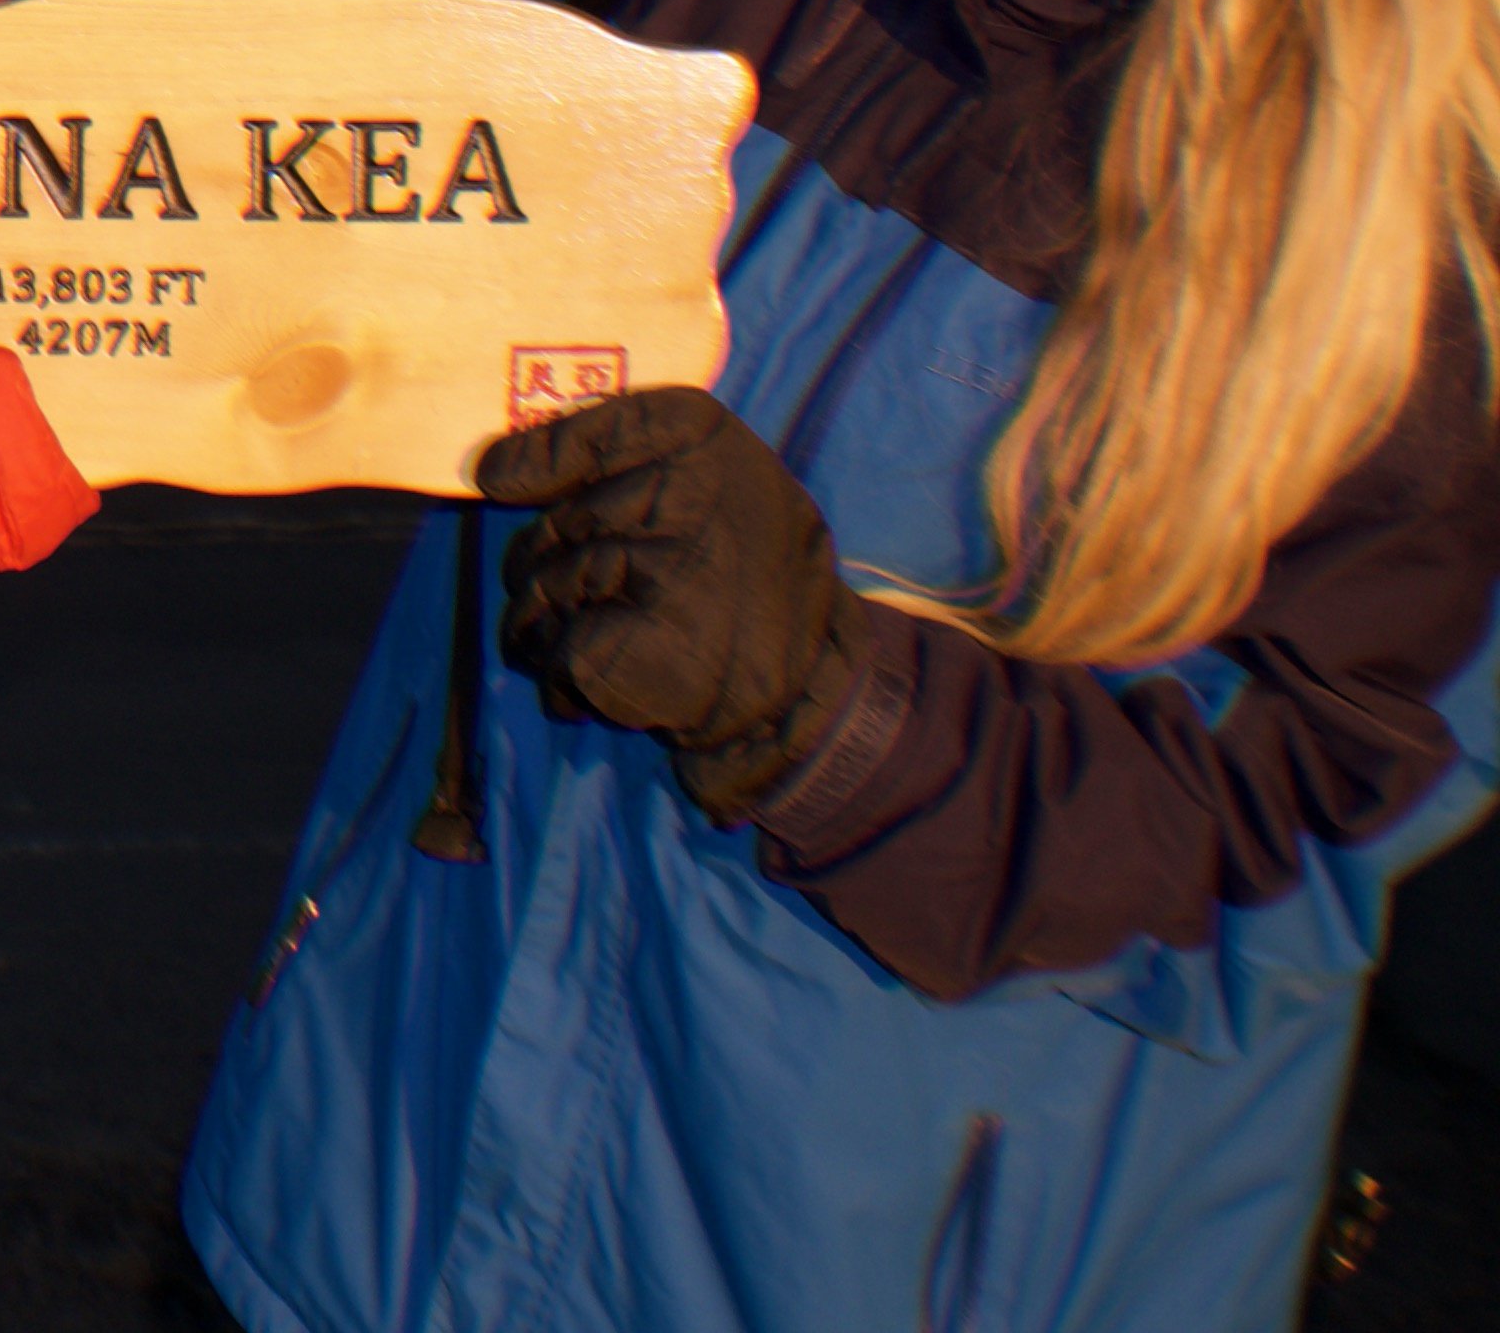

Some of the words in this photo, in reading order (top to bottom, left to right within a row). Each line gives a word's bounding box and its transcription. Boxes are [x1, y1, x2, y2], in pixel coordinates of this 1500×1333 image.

[242, 118, 530, 224] KEA
[146, 267, 207, 306] FT
[16, 318, 173, 358] 4207M
